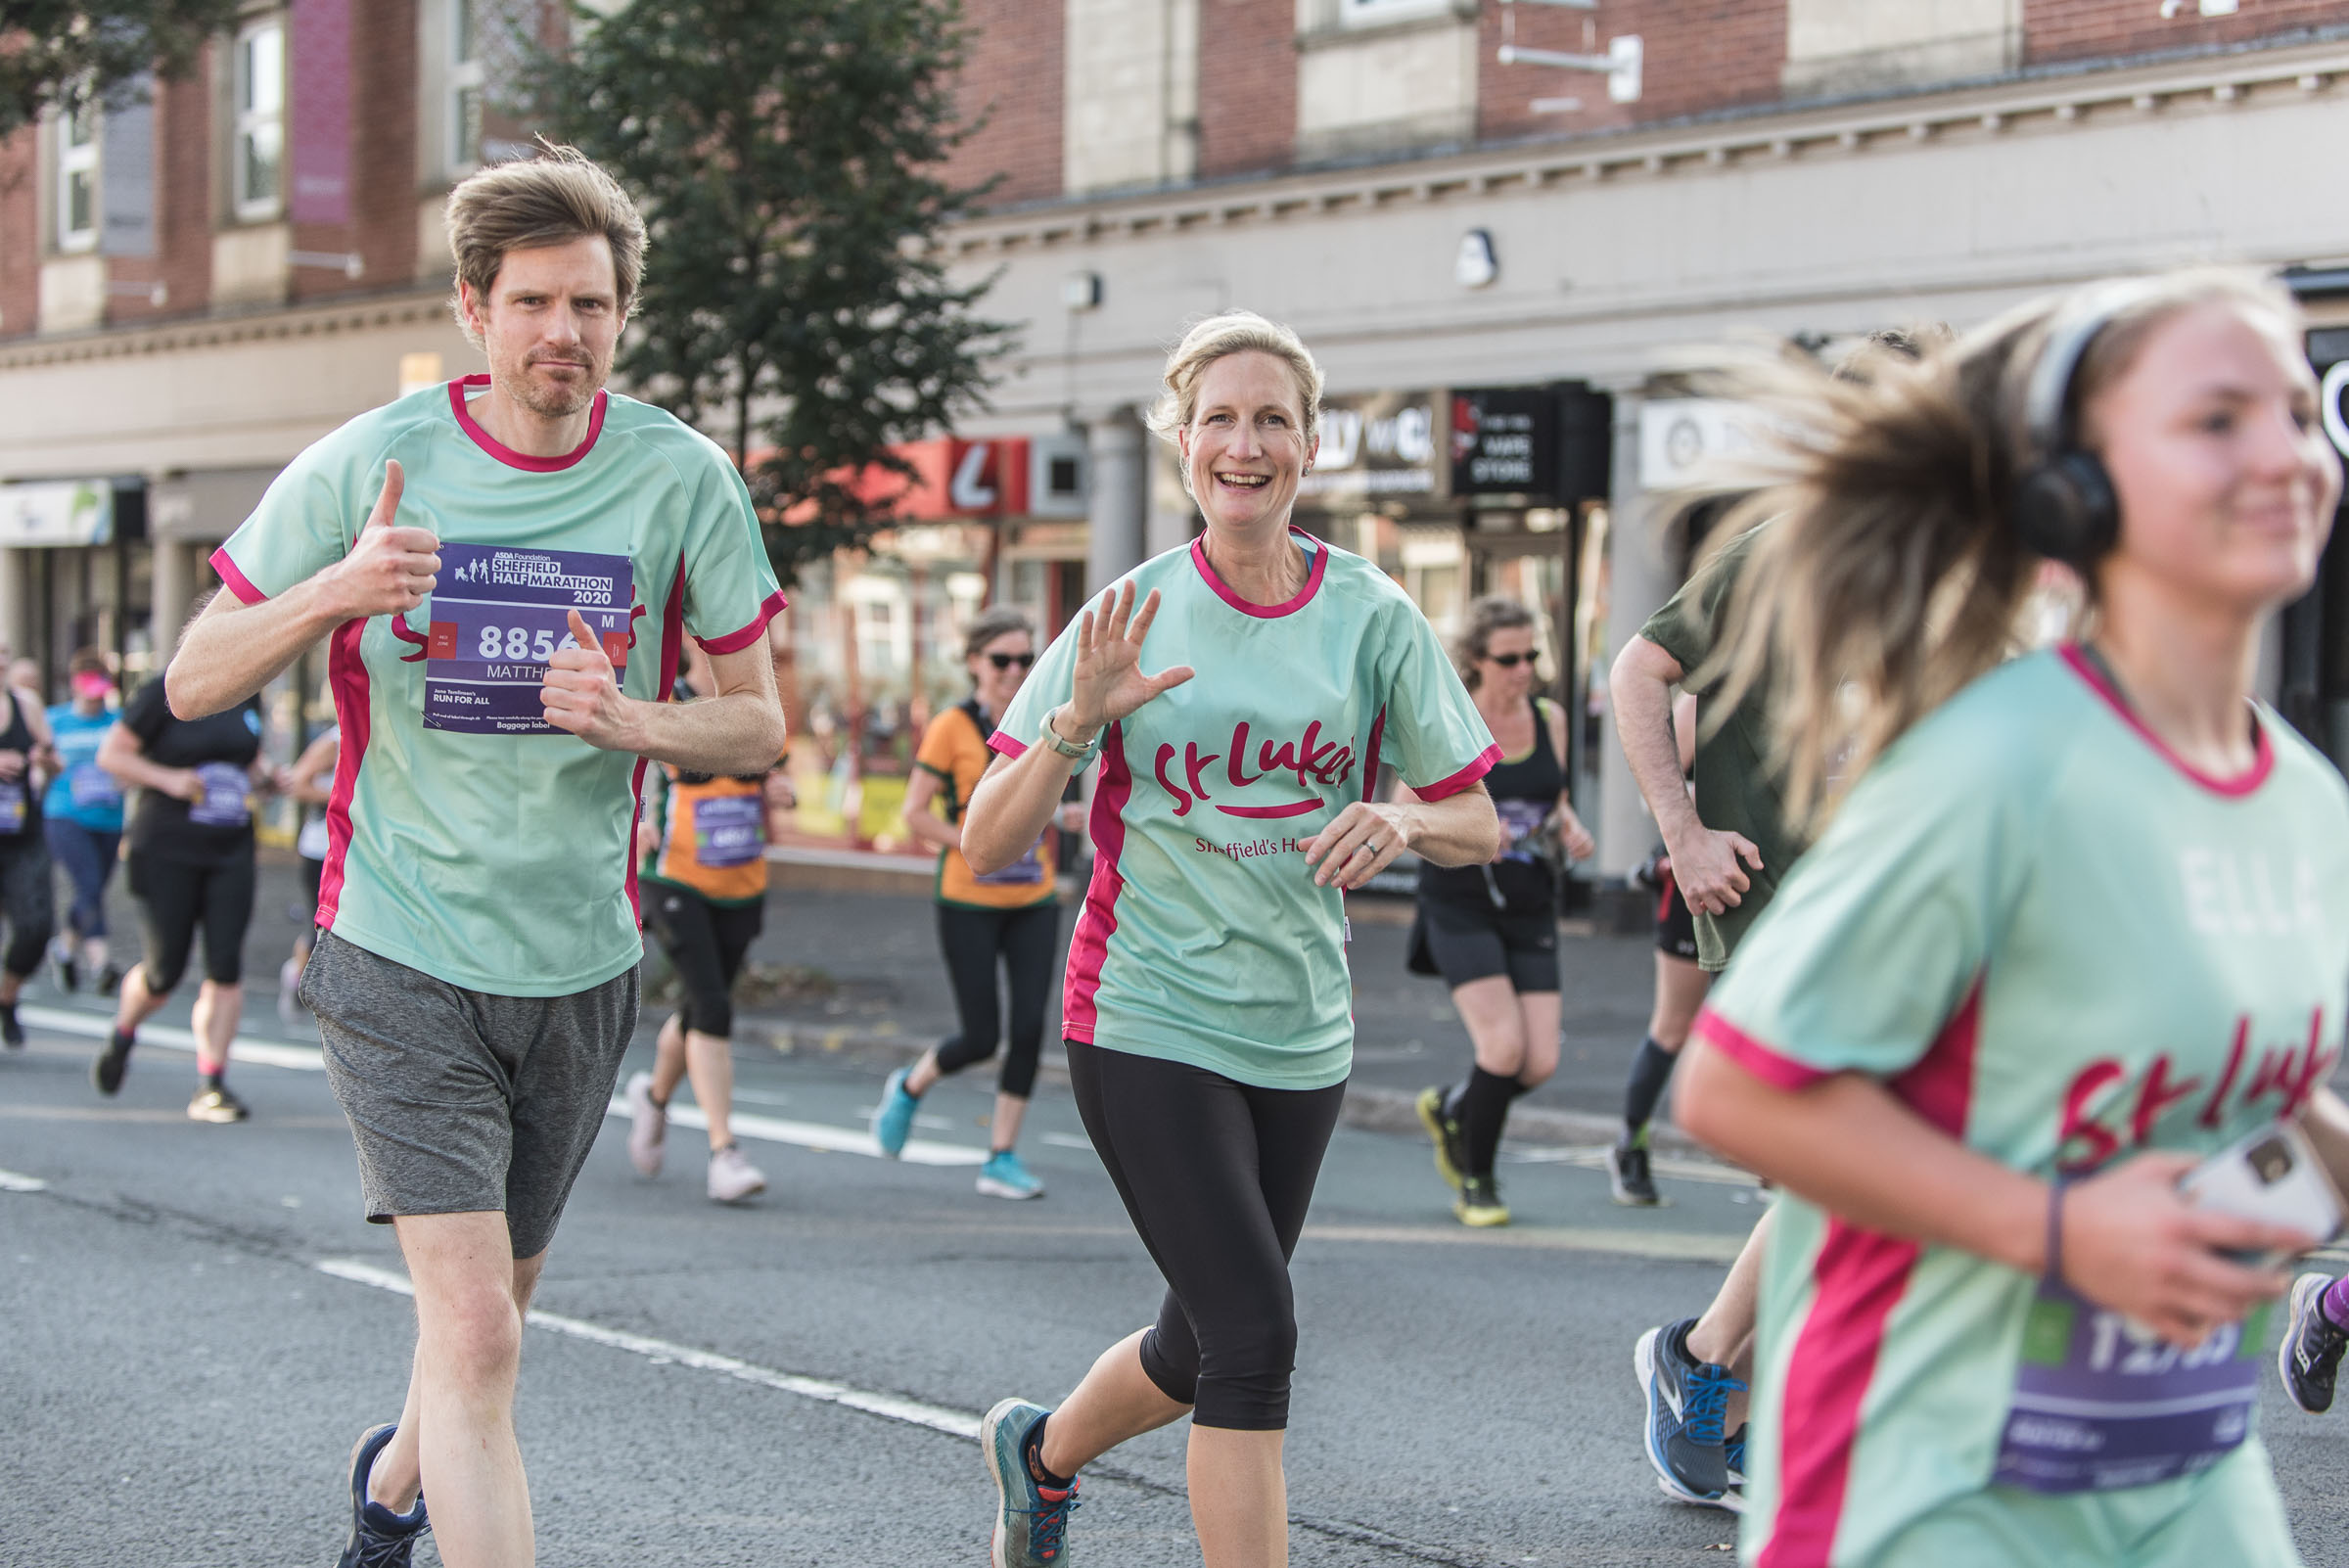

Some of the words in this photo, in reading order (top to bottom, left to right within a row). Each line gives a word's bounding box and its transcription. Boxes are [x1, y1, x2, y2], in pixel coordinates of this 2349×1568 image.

[494, 551, 514, 560] ASDA
[514, 553, 550, 562] Foundation
[493, 559, 559, 574] SHEFFIELD
[492, 573, 528, 585] HALF
[530, 575, 611, 590] MARATHON
[574, 590, 612, 605] 2020
[601, 615, 615, 628] M
[433, 694, 453, 704] RUN
[454, 695, 472, 705] FOR
[496, 721, 530, 730] Baggage
[531, 720, 550, 729] label
[1154, 740, 1221, 817] St
[2180, 848, 2324, 936] ELLA
